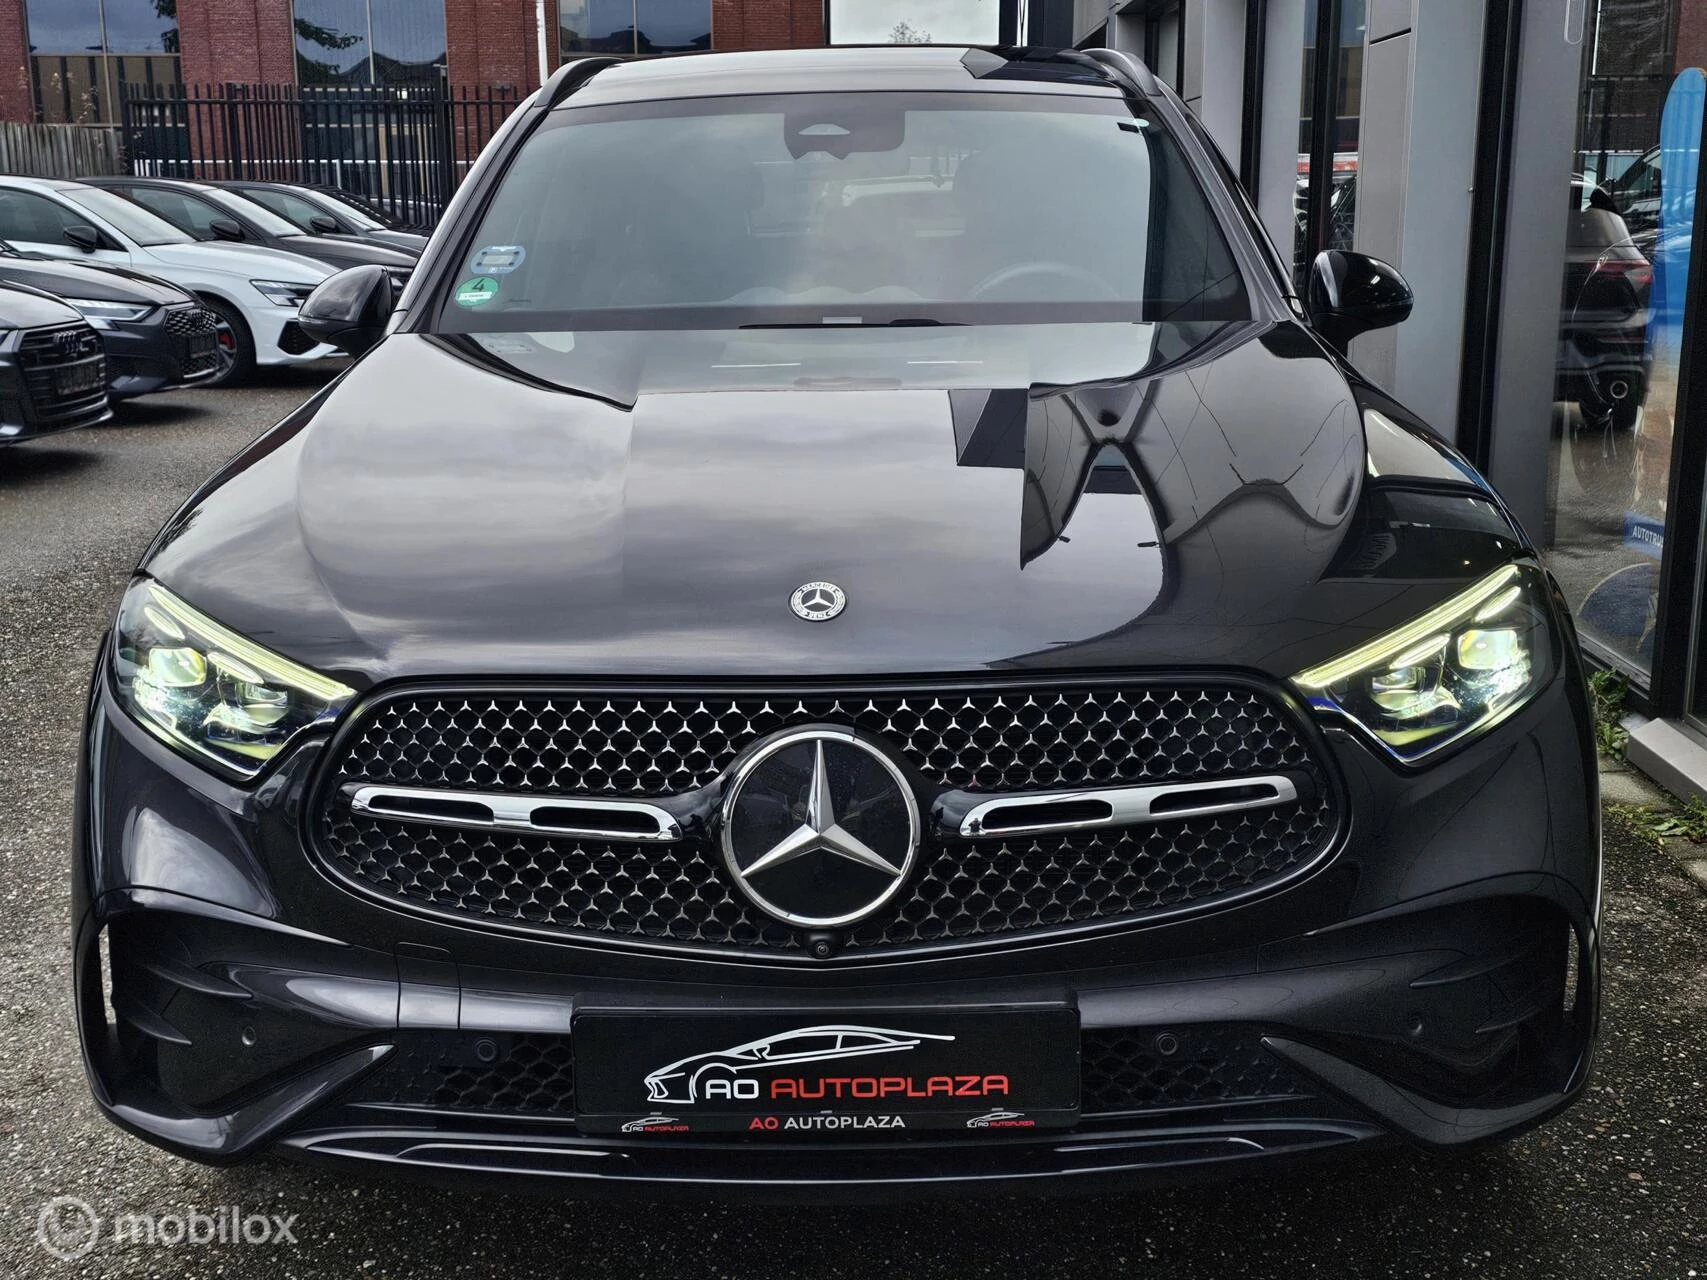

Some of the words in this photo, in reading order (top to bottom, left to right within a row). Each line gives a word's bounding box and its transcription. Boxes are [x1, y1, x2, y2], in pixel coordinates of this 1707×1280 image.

[472, 278, 485, 292] 4
[705, 1078, 760, 1100] AO
[770, 1074, 1009, 1099] AUTOPLAZA
[748, 1116, 779, 1130] AO
[784, 1115, 906, 1129] AUTOPLAZA
